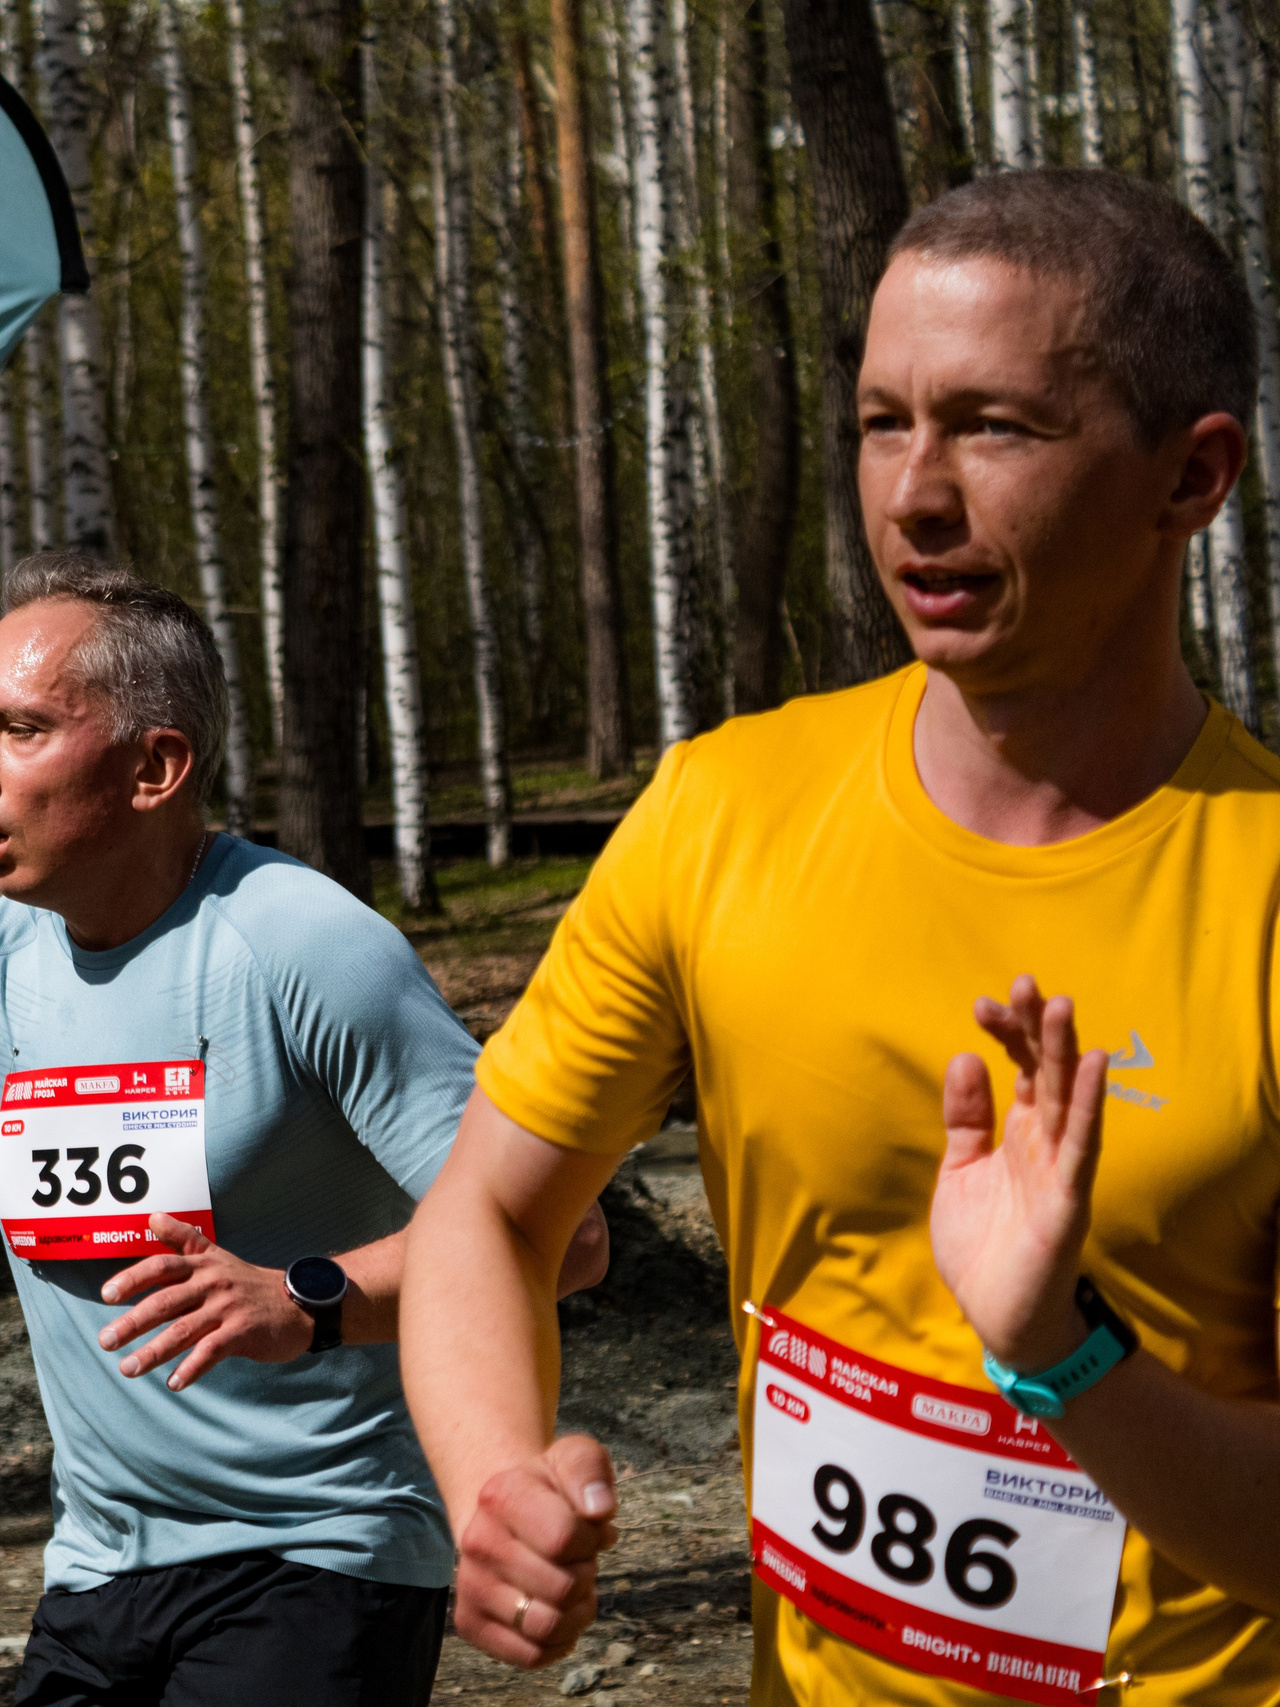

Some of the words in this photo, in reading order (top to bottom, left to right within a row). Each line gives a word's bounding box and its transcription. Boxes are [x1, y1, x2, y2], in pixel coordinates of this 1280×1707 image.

[34, 1077, 68, 1089] МАЙСКАЯ
[80, 1080, 116, 1091] MAKFA
[124, 1087, 156, 1095] HARPER
[33, 1089, 56, 1099] ГРОЗА
[122, 1108, 198, 1121] ВИКТОРИЯ
[4, 1123, 12, 1133] 10
[31, 1143, 150, 1208] 336
[830, 1355, 900, 1398] МАЙСКАЯ
[829, 1372, 872, 1403] ГРОЗА
[771, 1389, 786, 1408] 10
[921, 1402, 982, 1429] MAKFA
[997, 1434, 1051, 1453] HARPER
[810, 1463, 1021, 1610] 986
[986, 1651, 1081, 1692] BERGAUER
